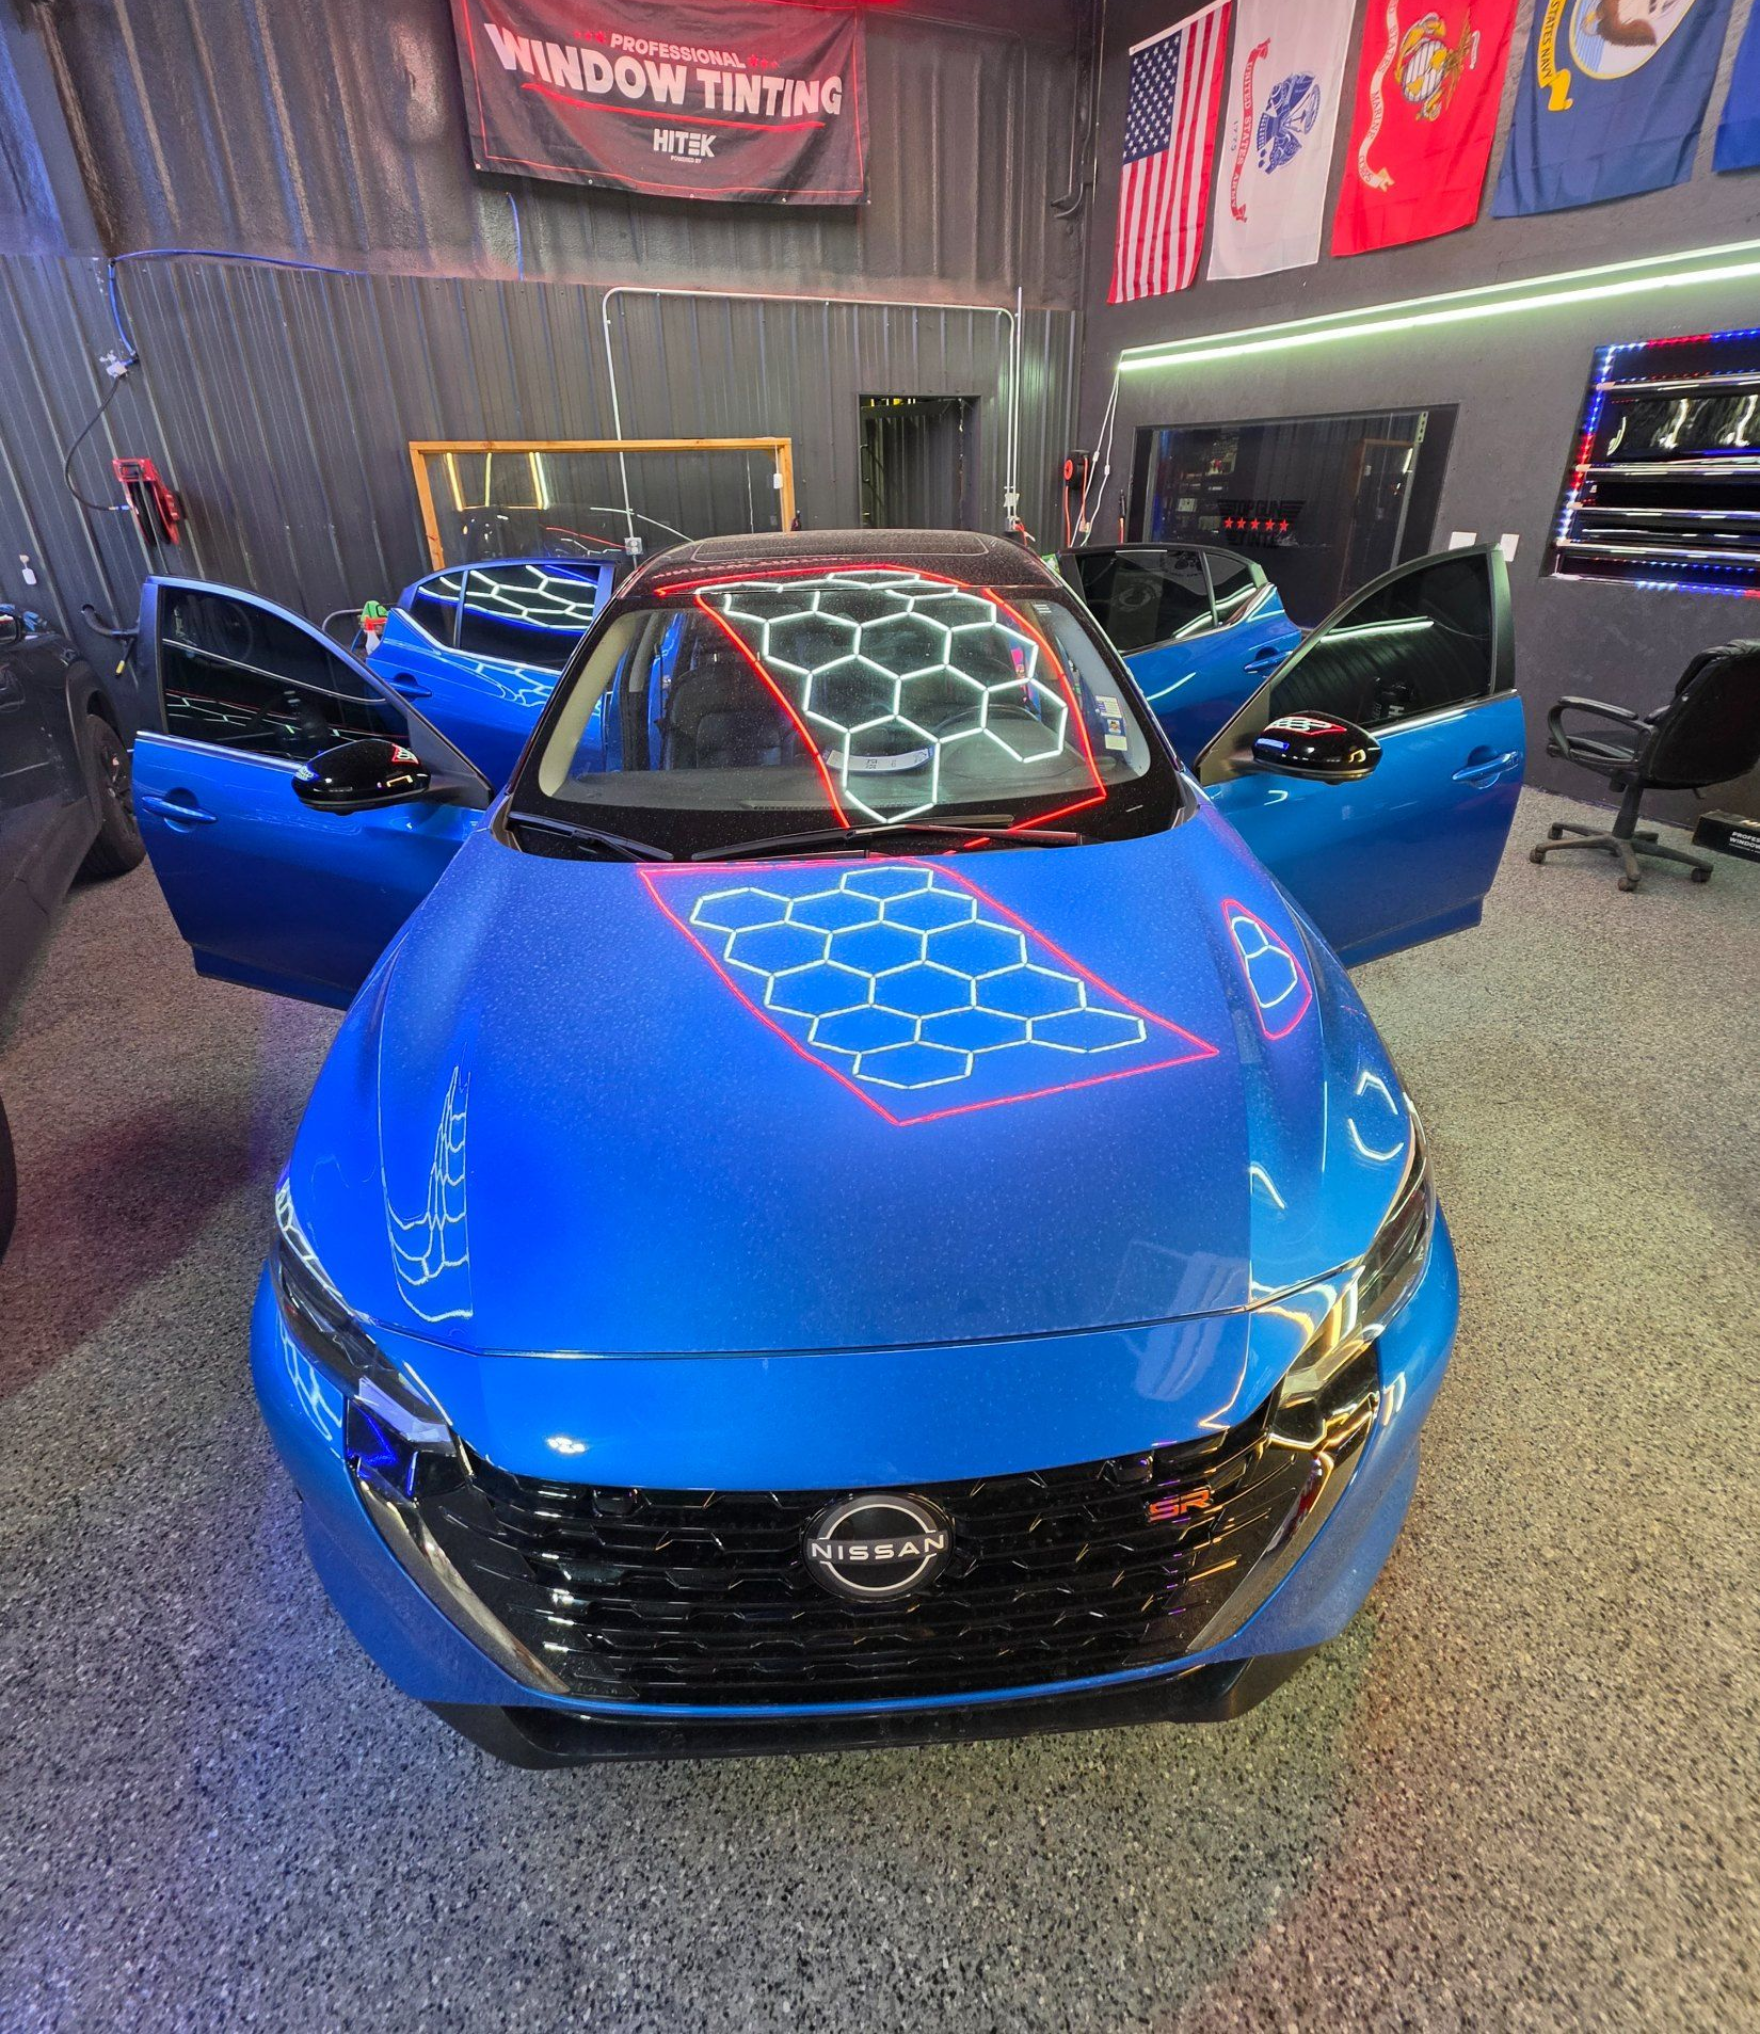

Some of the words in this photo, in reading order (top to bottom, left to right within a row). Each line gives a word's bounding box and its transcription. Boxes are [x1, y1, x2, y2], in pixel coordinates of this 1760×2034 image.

[1542, 0, 1560, 46] STATES
[484, 23, 687, 105] WINDOW
[696, 68, 843, 117] TINTING
[610, 33, 747, 69] PROFESSIONAL
[1378, 24, 1397, 75] STATES
[1539, 48, 1552, 80] NAVY
[1243, 61, 1254, 109] UNITED
[1366, 90, 1381, 140] MARINE
[653, 128, 717, 157] HITEK
[1237, 115, 1252, 165] STATES
[1230, 172, 1240, 208] ARMY
[1147, 1488, 1212, 1523] SR
[811, 1534, 945, 1560] NISSAN
